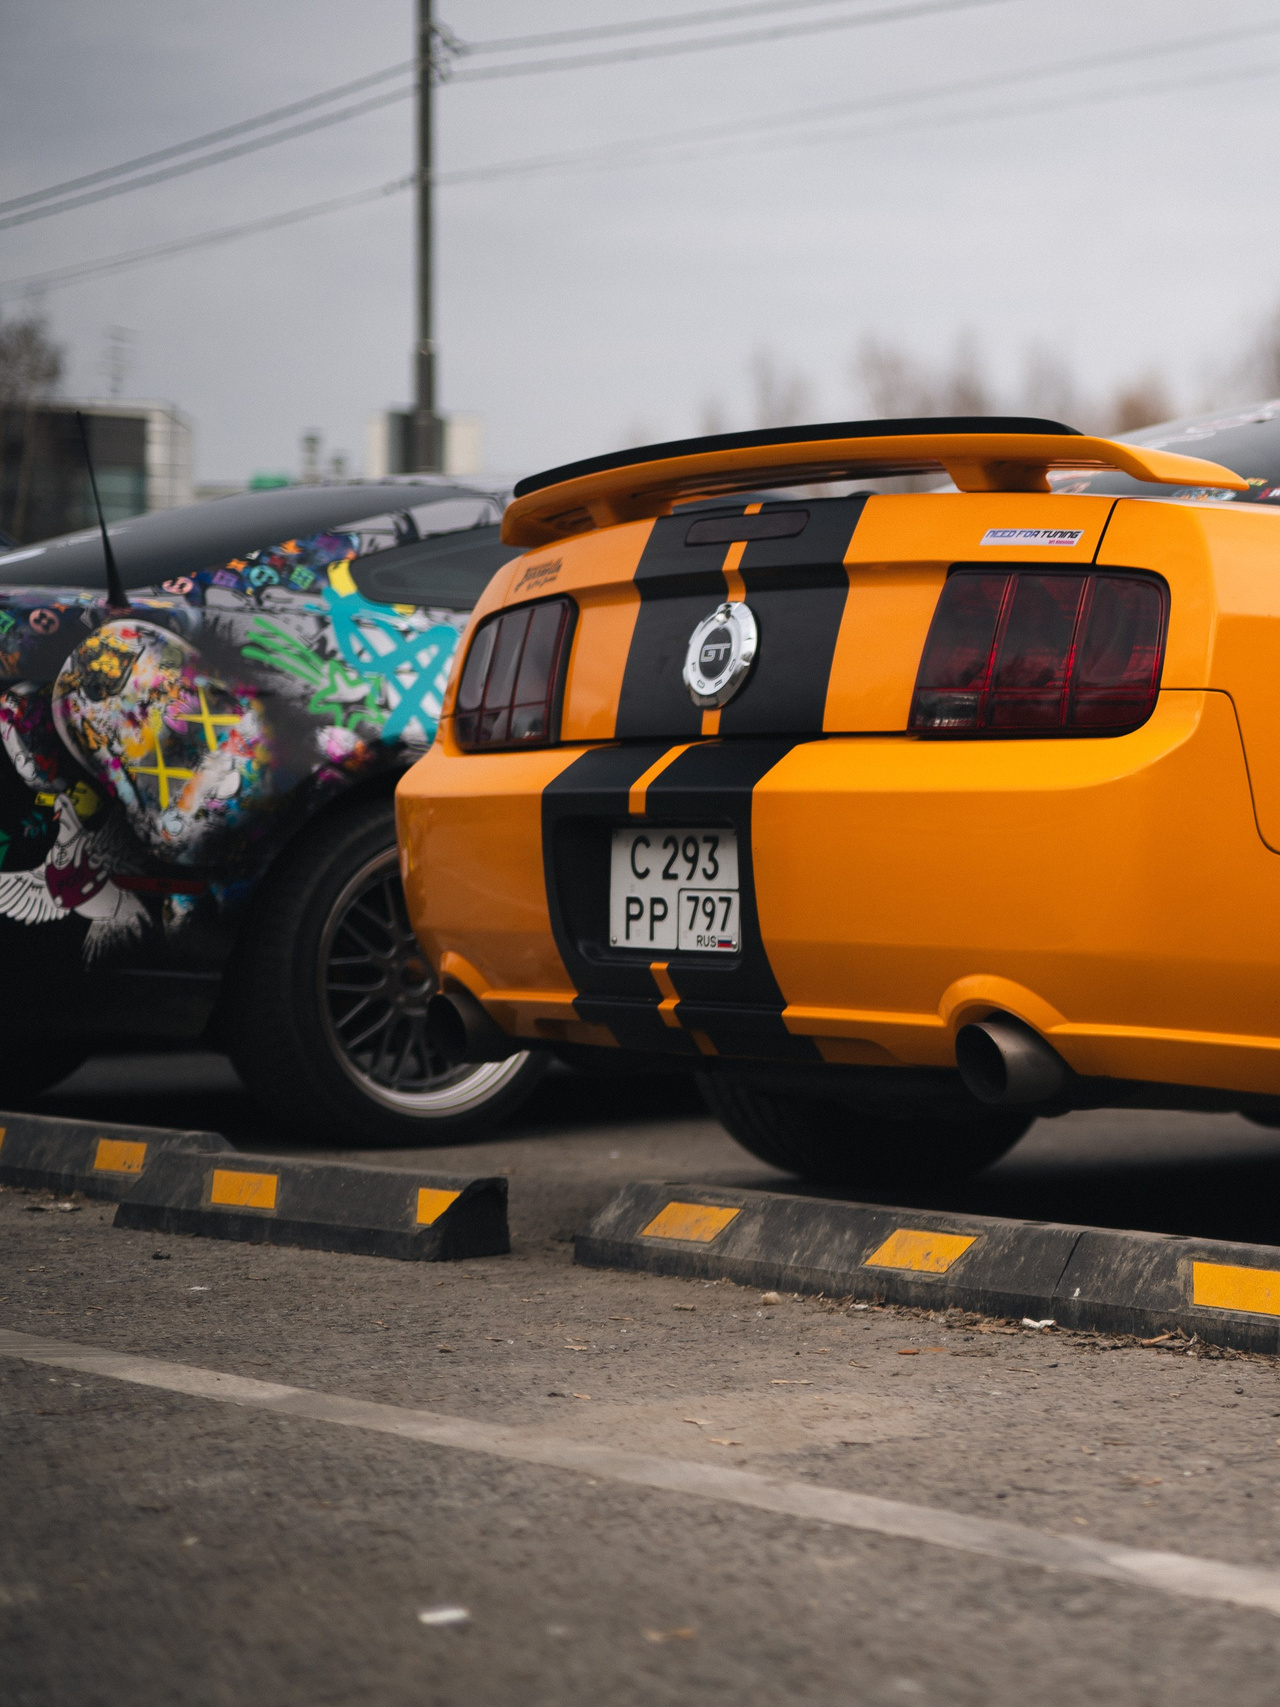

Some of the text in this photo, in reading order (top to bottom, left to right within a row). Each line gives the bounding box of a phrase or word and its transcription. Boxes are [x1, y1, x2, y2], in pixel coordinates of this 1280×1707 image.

[985, 530, 1082, 539] NEED FOR TUNING
[700, 642, 731, 663] GT
[631, 835, 720, 881] C 293
[625, 896, 669, 941] PP
[686, 896, 732, 932] 797
[696, 935, 717, 948] RUS
